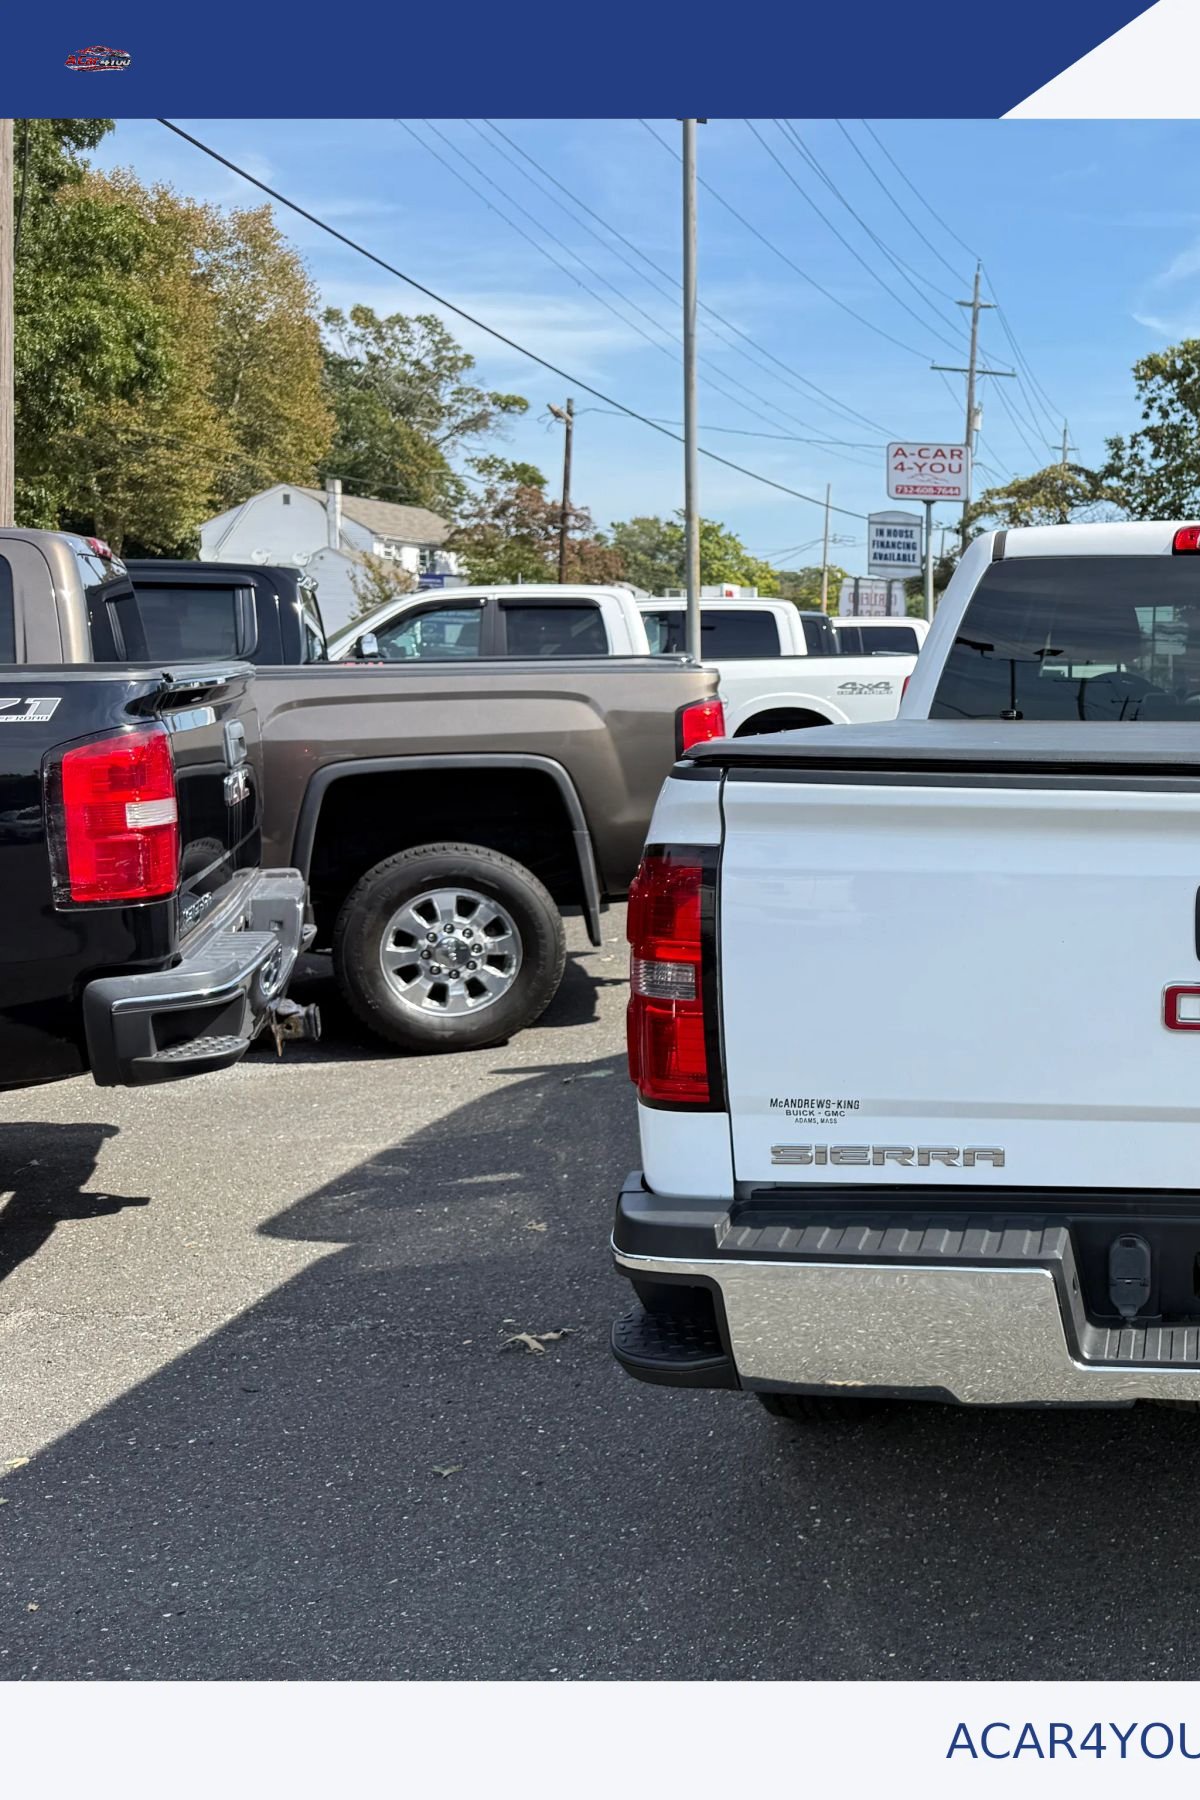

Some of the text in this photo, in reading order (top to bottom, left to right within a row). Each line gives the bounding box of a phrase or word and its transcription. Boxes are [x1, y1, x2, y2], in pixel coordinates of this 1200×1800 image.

[893, 447, 963, 460] A-CAR
[894, 462, 962, 474] 4-YOU
[875, 528, 914, 539] IN HOUSE
[872, 541, 917, 550] FINANCING
[872, 552, 916, 563] AVAILABLE
[837, 682, 893, 690] 4x4
[769, 1098, 860, 1109] McANDREWS-KING
[770, 1144, 1006, 1168] SIERRA
